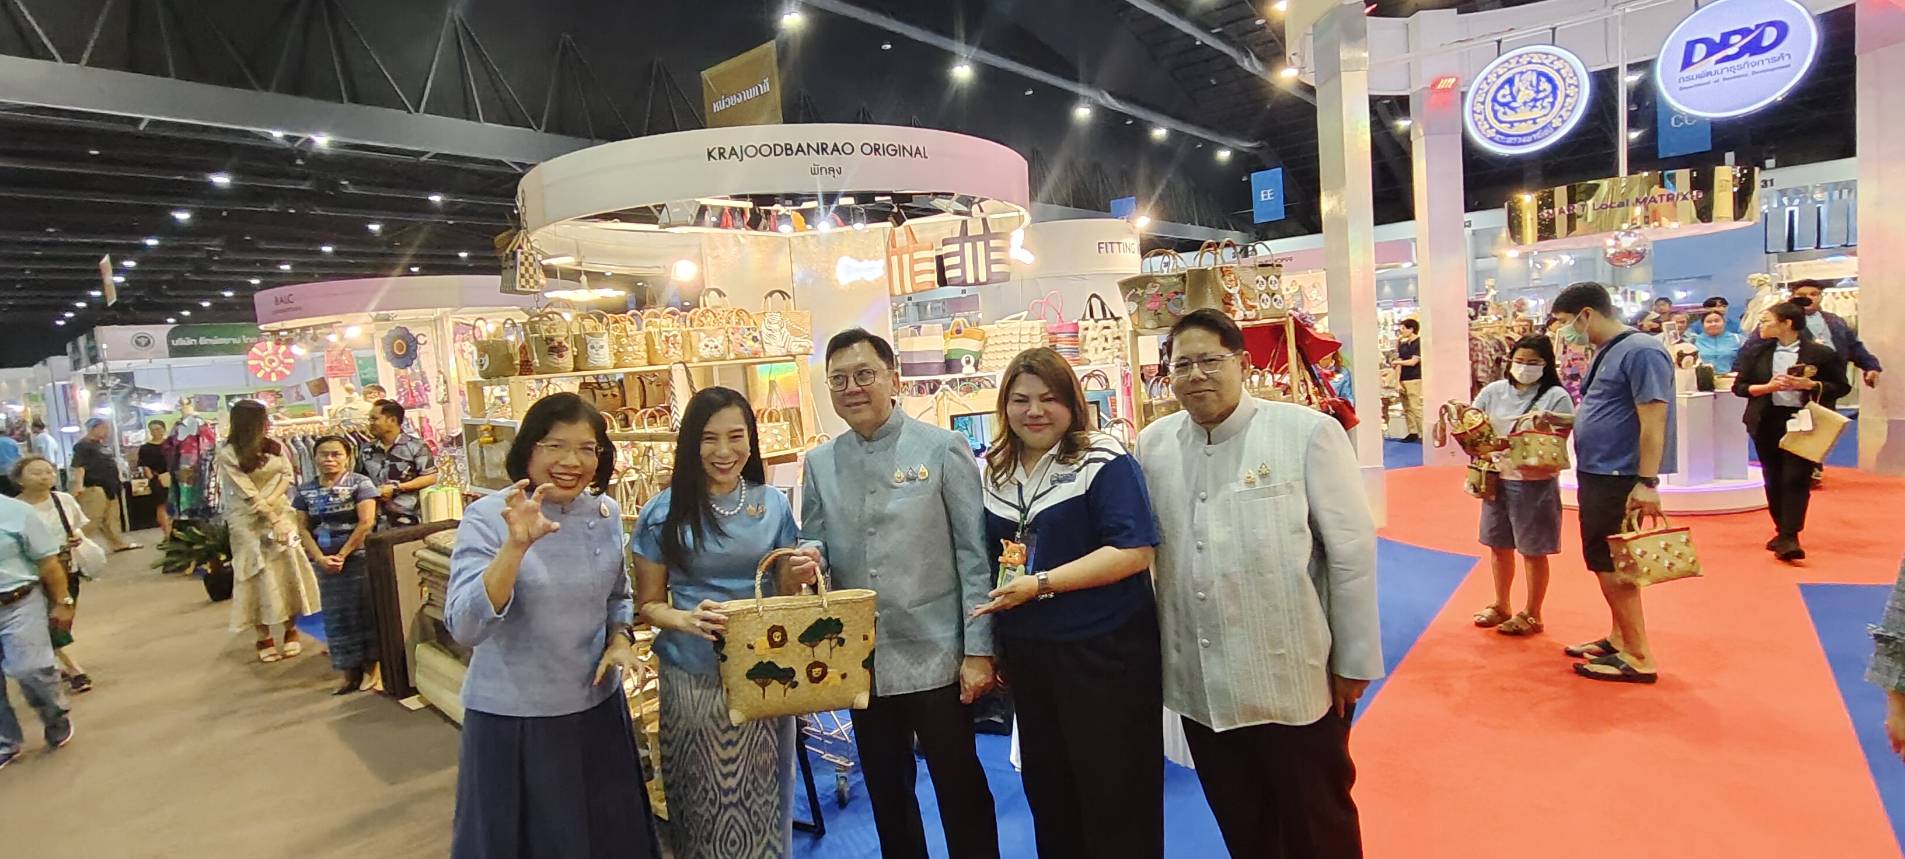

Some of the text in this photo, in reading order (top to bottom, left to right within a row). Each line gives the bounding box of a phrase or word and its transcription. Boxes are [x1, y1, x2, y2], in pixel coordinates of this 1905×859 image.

[1680, 20, 1789, 73] DBD
[707, 142, 929, 162] KRAJOODBANRAO ORIGINAL
[1260, 188, 1275, 201] EE
[1593, 198, 1630, 212] Local
[1097, 241, 1136, 255] FITTING
